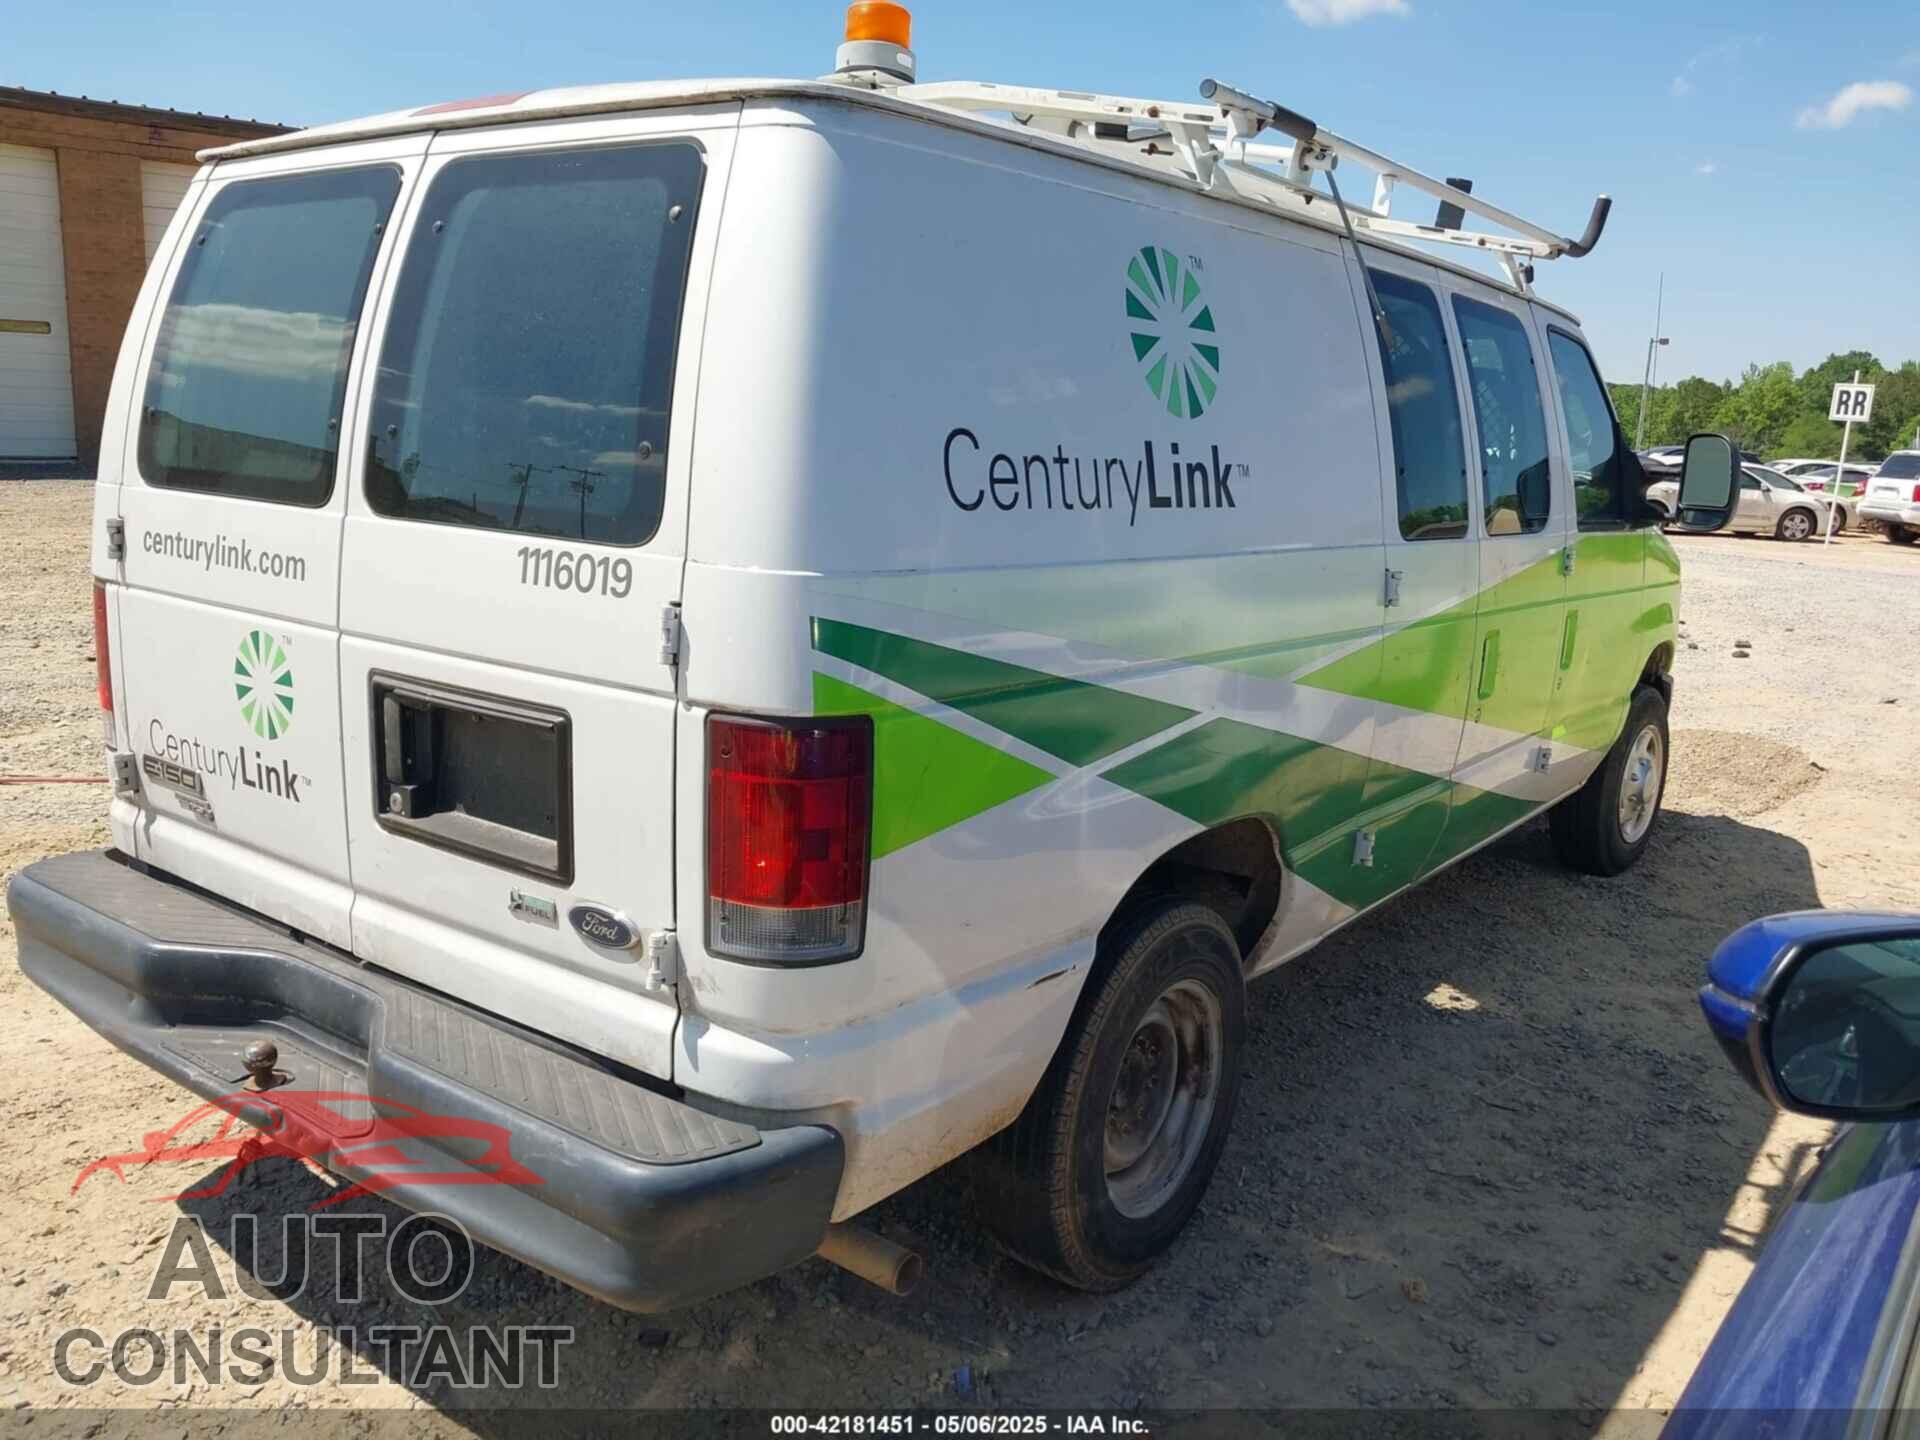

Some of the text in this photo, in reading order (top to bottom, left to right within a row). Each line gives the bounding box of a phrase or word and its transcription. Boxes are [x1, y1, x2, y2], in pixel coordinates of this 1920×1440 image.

[1835, 390, 1867, 416] RR
[943, 427, 1236, 526] CenturyLink
[143, 530, 306, 581] centurylink.com
[517, 546, 633, 599] 1116019
[149, 718, 301, 803] CenturyLink
[581, 912, 618, 940] Ford
